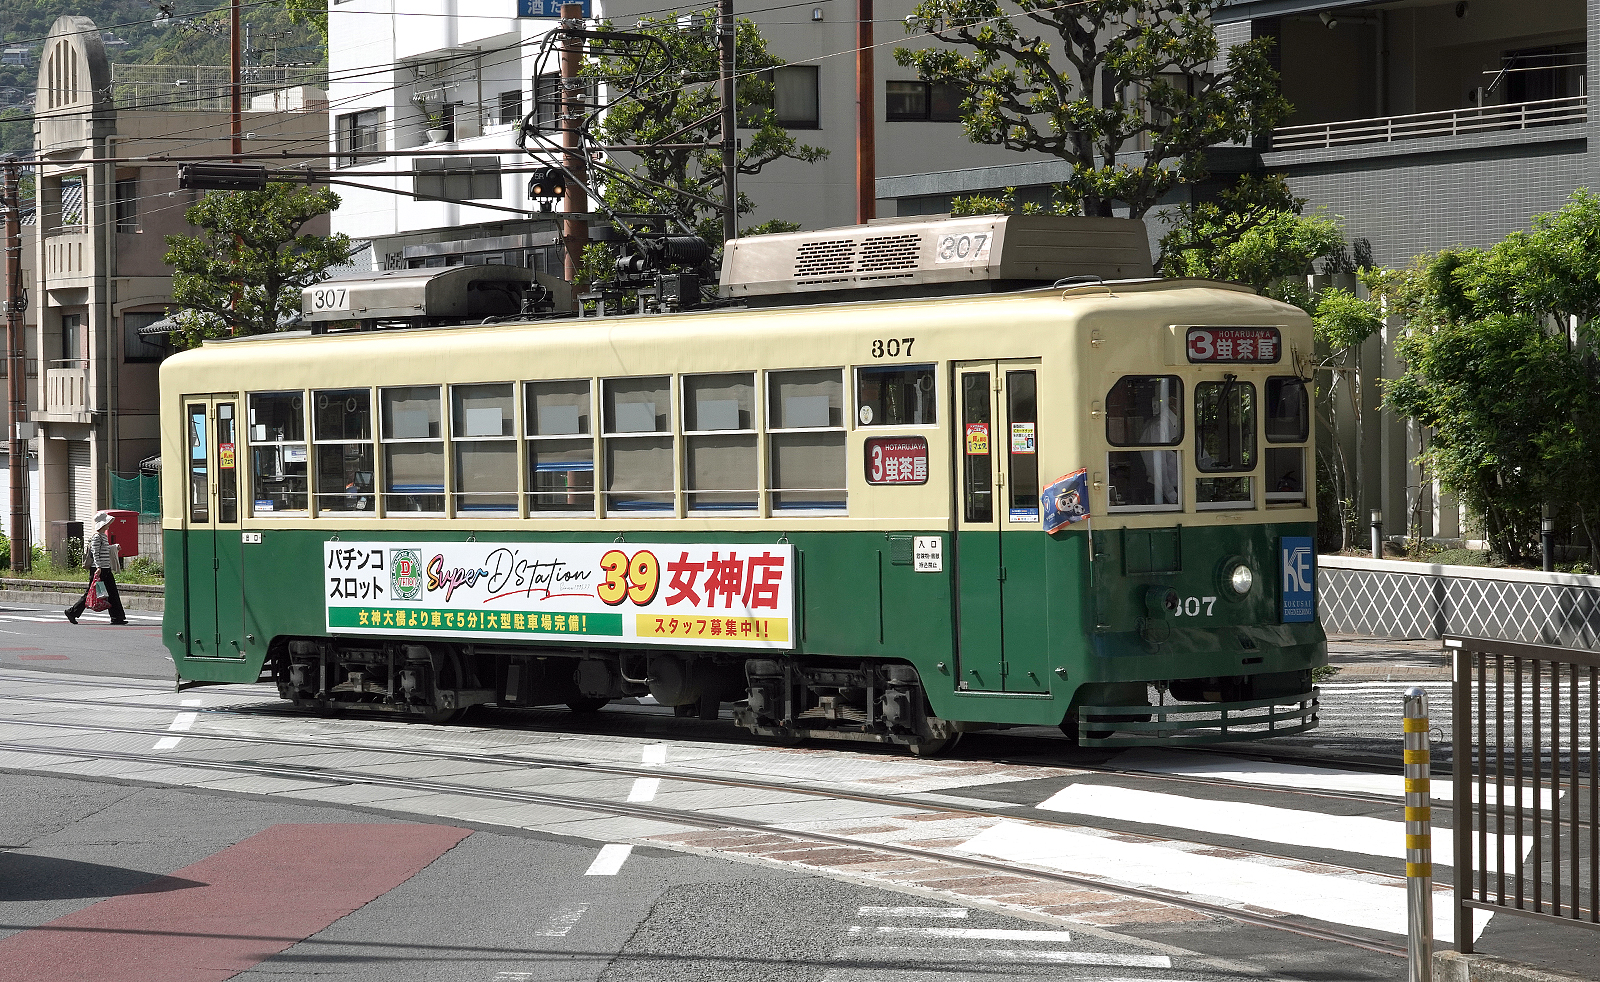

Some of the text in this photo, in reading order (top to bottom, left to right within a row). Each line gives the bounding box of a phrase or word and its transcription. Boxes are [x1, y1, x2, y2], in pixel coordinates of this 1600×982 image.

[527, 0, 544, 15] 酒
[940, 234, 988, 260] 307
[315, 289, 347, 309] 307
[1188, 330, 1274, 360] 3 蛍茶屋
[1218, 330, 1271, 338] HOTARUJAYA
[871, 337, 916, 359] 307
[885, 443, 926, 451] HOTARUJAYA
[871, 444, 927, 481] 3 蛍茶屋
[327, 547, 384, 571] パチンコ
[1283, 546, 1312, 592] KE
[329, 576, 384, 600] スロット
[426, 553, 490, 603] Super
[597, 549, 661, 607] 39
[664, 551, 785, 610] 女神店
[1283, 600, 1312, 608] KOKUSAI
[654, 617, 769, 638] スタッフ募集中!!
